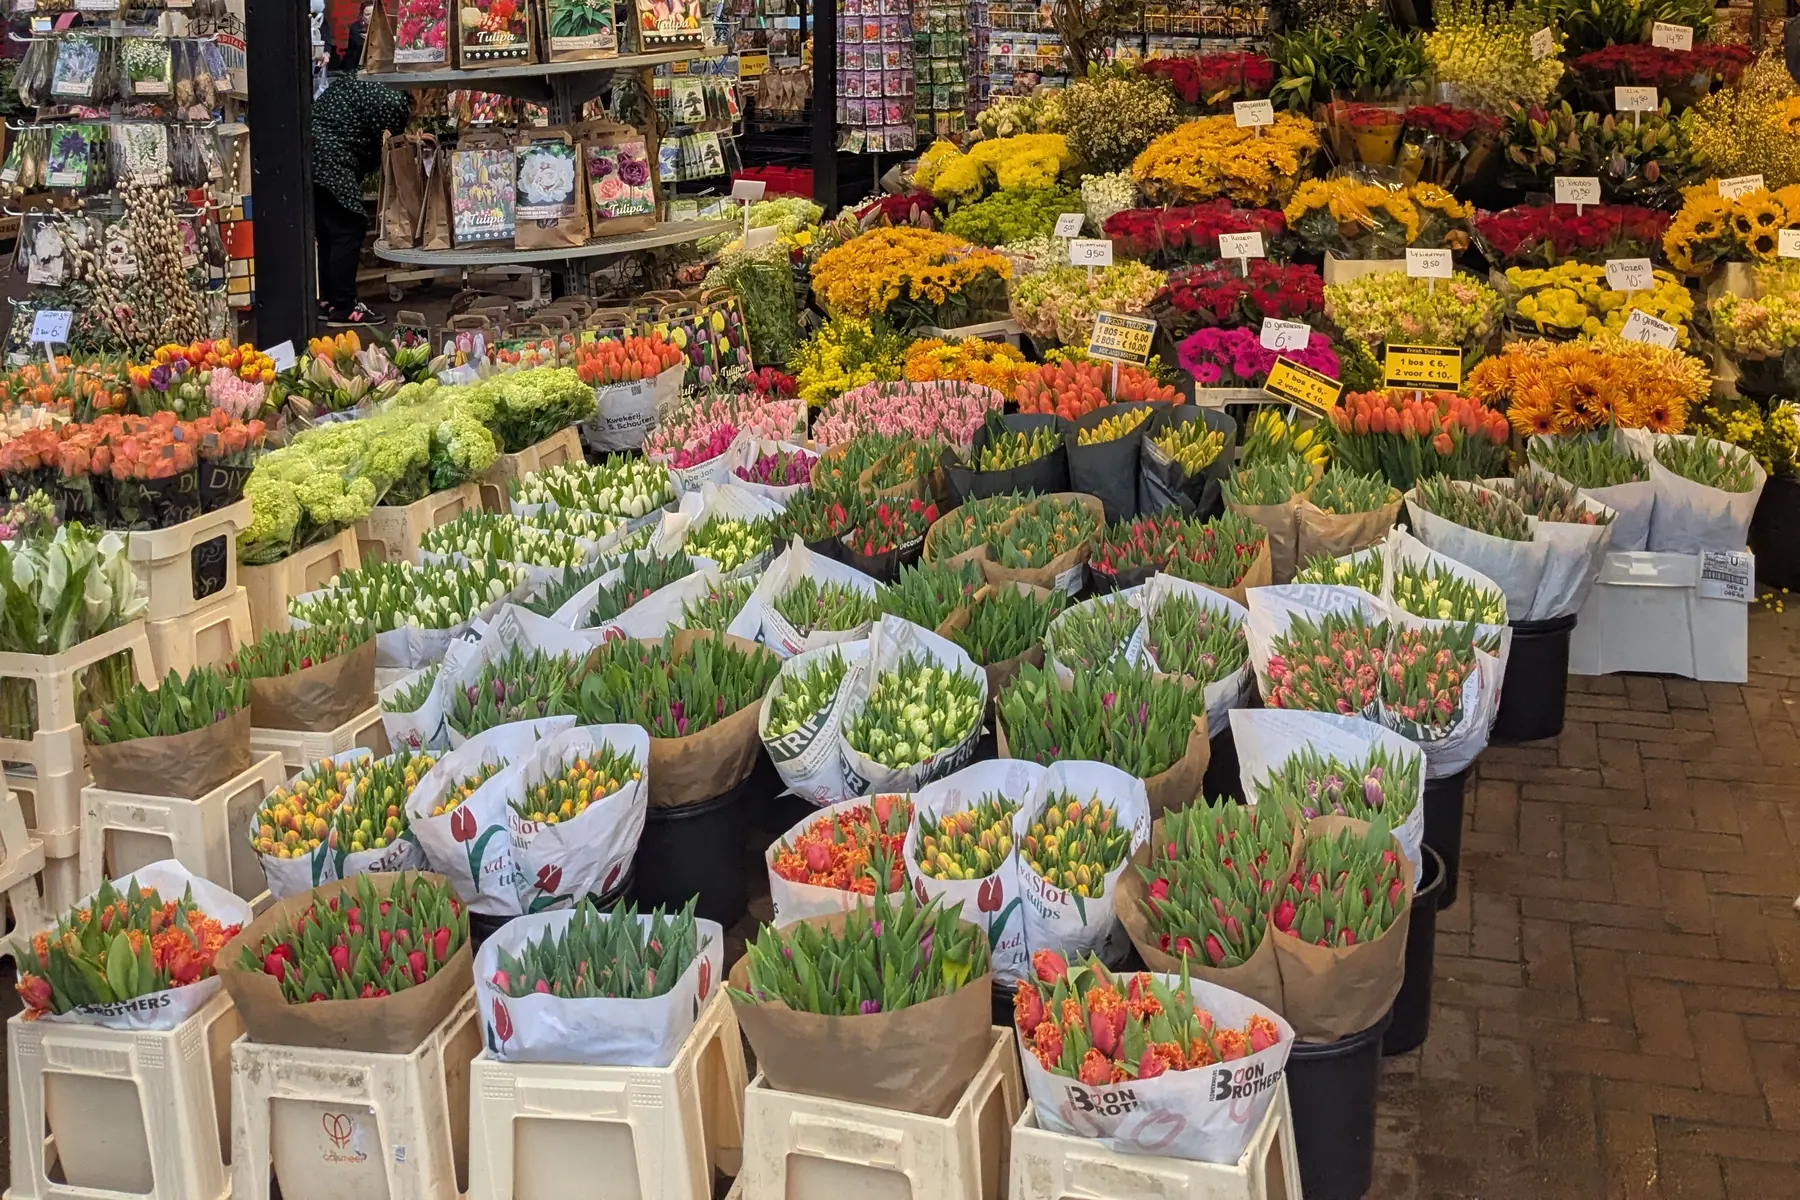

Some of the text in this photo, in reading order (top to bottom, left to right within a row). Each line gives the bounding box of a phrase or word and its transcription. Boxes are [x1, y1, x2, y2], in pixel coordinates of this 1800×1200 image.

[655, 18, 689, 30] Tulipa
[476, 31, 516, 43] Tulipa
[608, 202, 644, 216] Tulipa
[470, 213, 506, 226] Tulipa
[1104, 317, 1148, 331] FRESH TULIPS
[1099, 326, 1103, 334] 1
[1103, 326, 1119, 337] BOS
[1134, 333, 1149, 344] 6,00
[1095, 335, 1101, 343] 2
[1101, 335, 1116, 346] BOS
[1128, 341, 1147, 353] 10,00
[1120, 351, 1139, 361] MATCH
[1408, 358, 1424, 367] bos
[1429, 359, 1435, 367] €
[720, 364, 746, 380] Tulipa
[1395, 368, 1401, 376] 2
[1428, 370, 1434, 378] €
[1277, 378, 1284, 386] 2
[1284, 383, 1303, 394] voor
[1291, 375, 1306, 386] bos
[606, 412, 642, 424] Kwekerij
[616, 415, 655, 430] Schouten
[209, 468, 248, 490] DIY
[688, 468, 714, 483] De Jon
[1730, 556, 1739, 567] U
[1033, 875, 1070, 906] Slot
[1026, 888, 1061, 920] tulips
